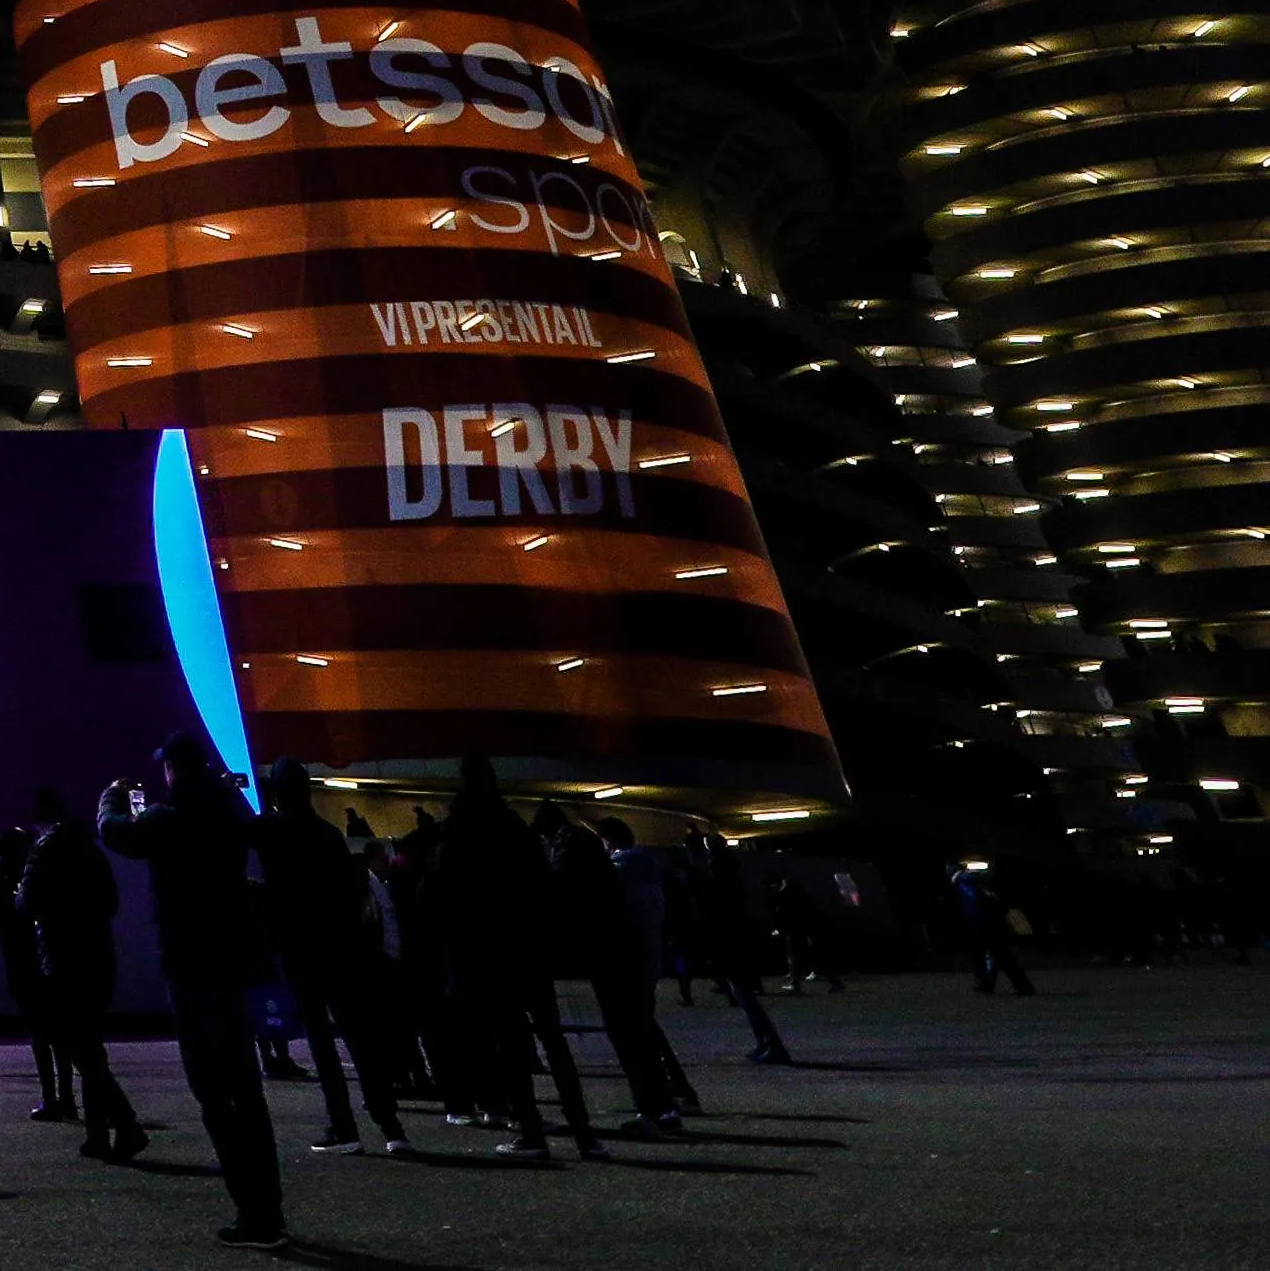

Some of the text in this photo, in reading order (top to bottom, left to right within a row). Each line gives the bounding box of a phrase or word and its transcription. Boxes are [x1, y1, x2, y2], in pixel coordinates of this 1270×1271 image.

[370, 298, 603, 348] VI PRESENTA IL
[381, 402, 636, 521] DERBY
